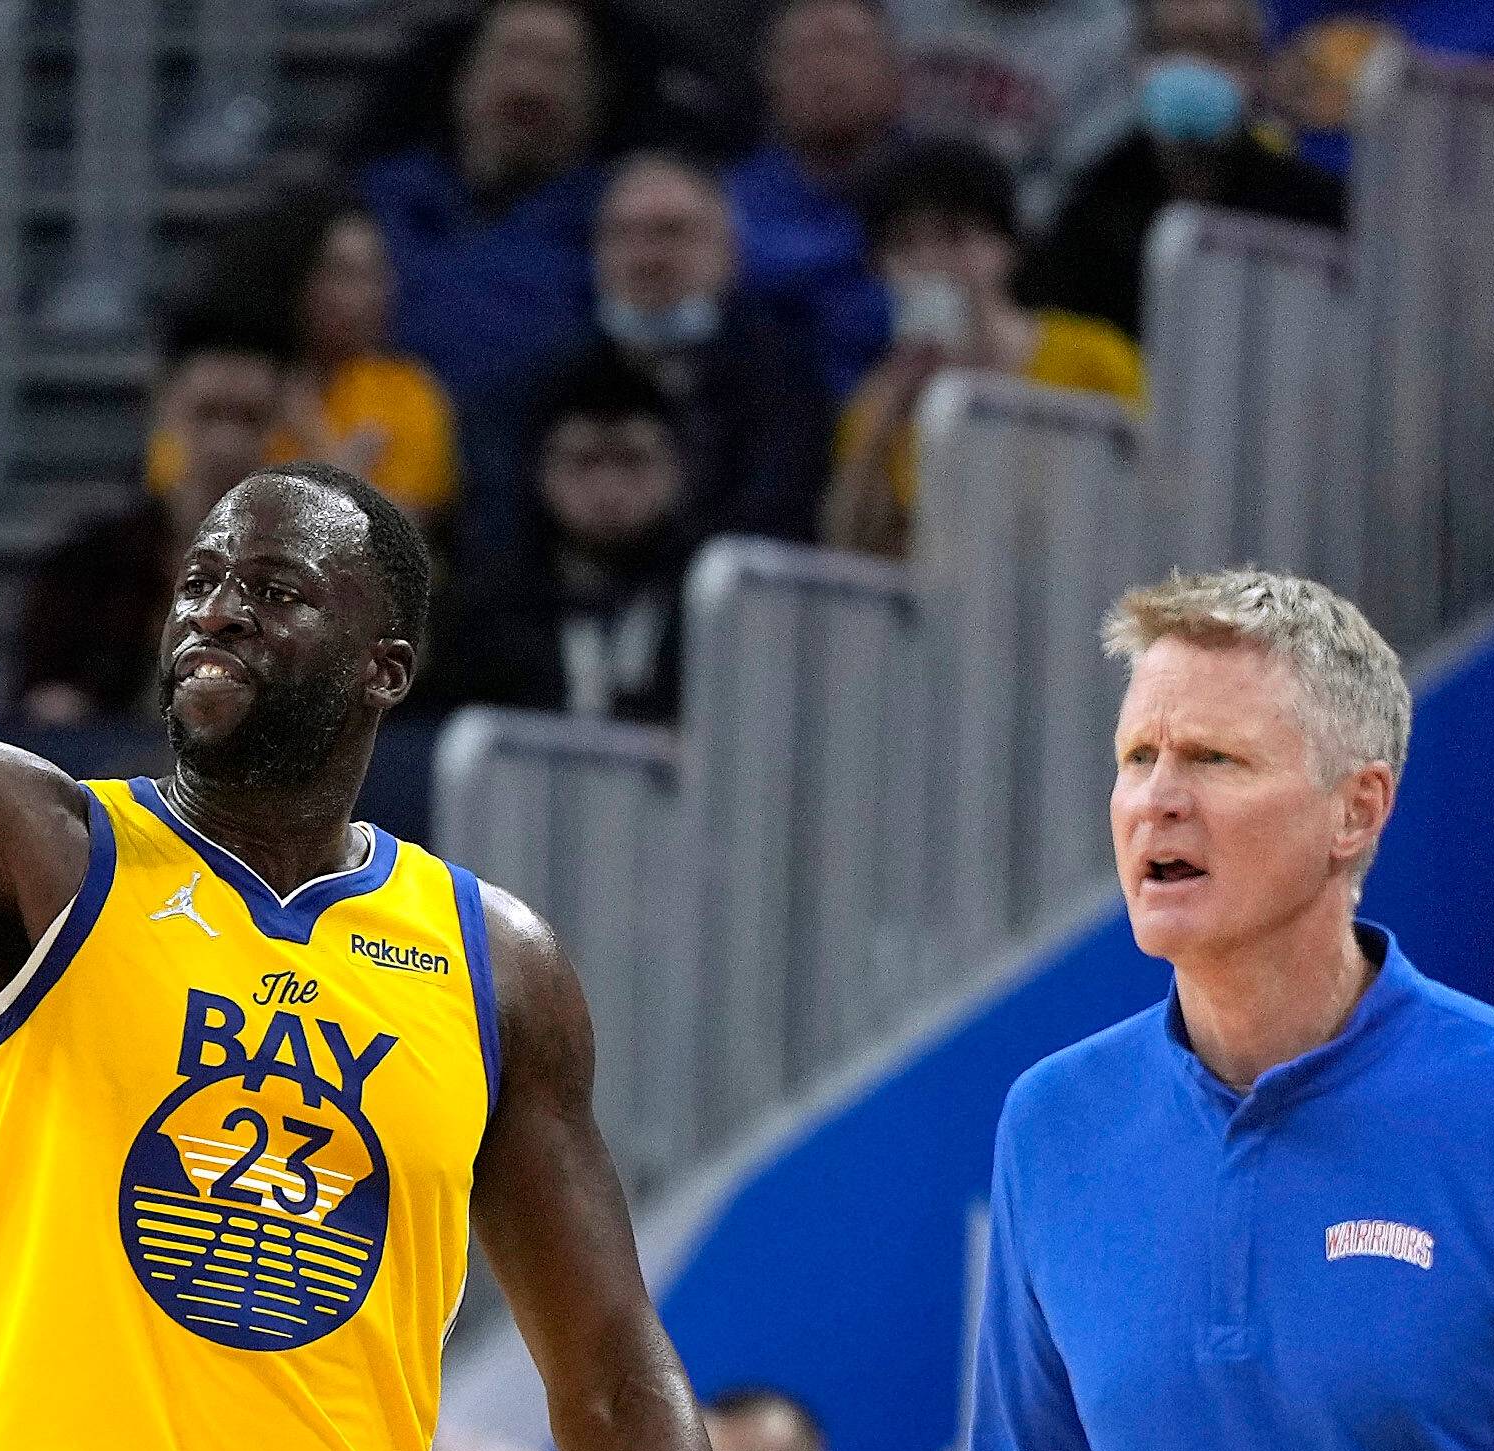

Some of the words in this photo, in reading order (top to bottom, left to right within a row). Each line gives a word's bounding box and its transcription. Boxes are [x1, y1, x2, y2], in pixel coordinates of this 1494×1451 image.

[350, 933, 449, 975] Rakuten
[252, 970, 318, 1006] The
[176, 987, 398, 1112] BAY
[210, 1107, 334, 1216] 23
[1325, 1219, 1435, 1271] WARRIORS
